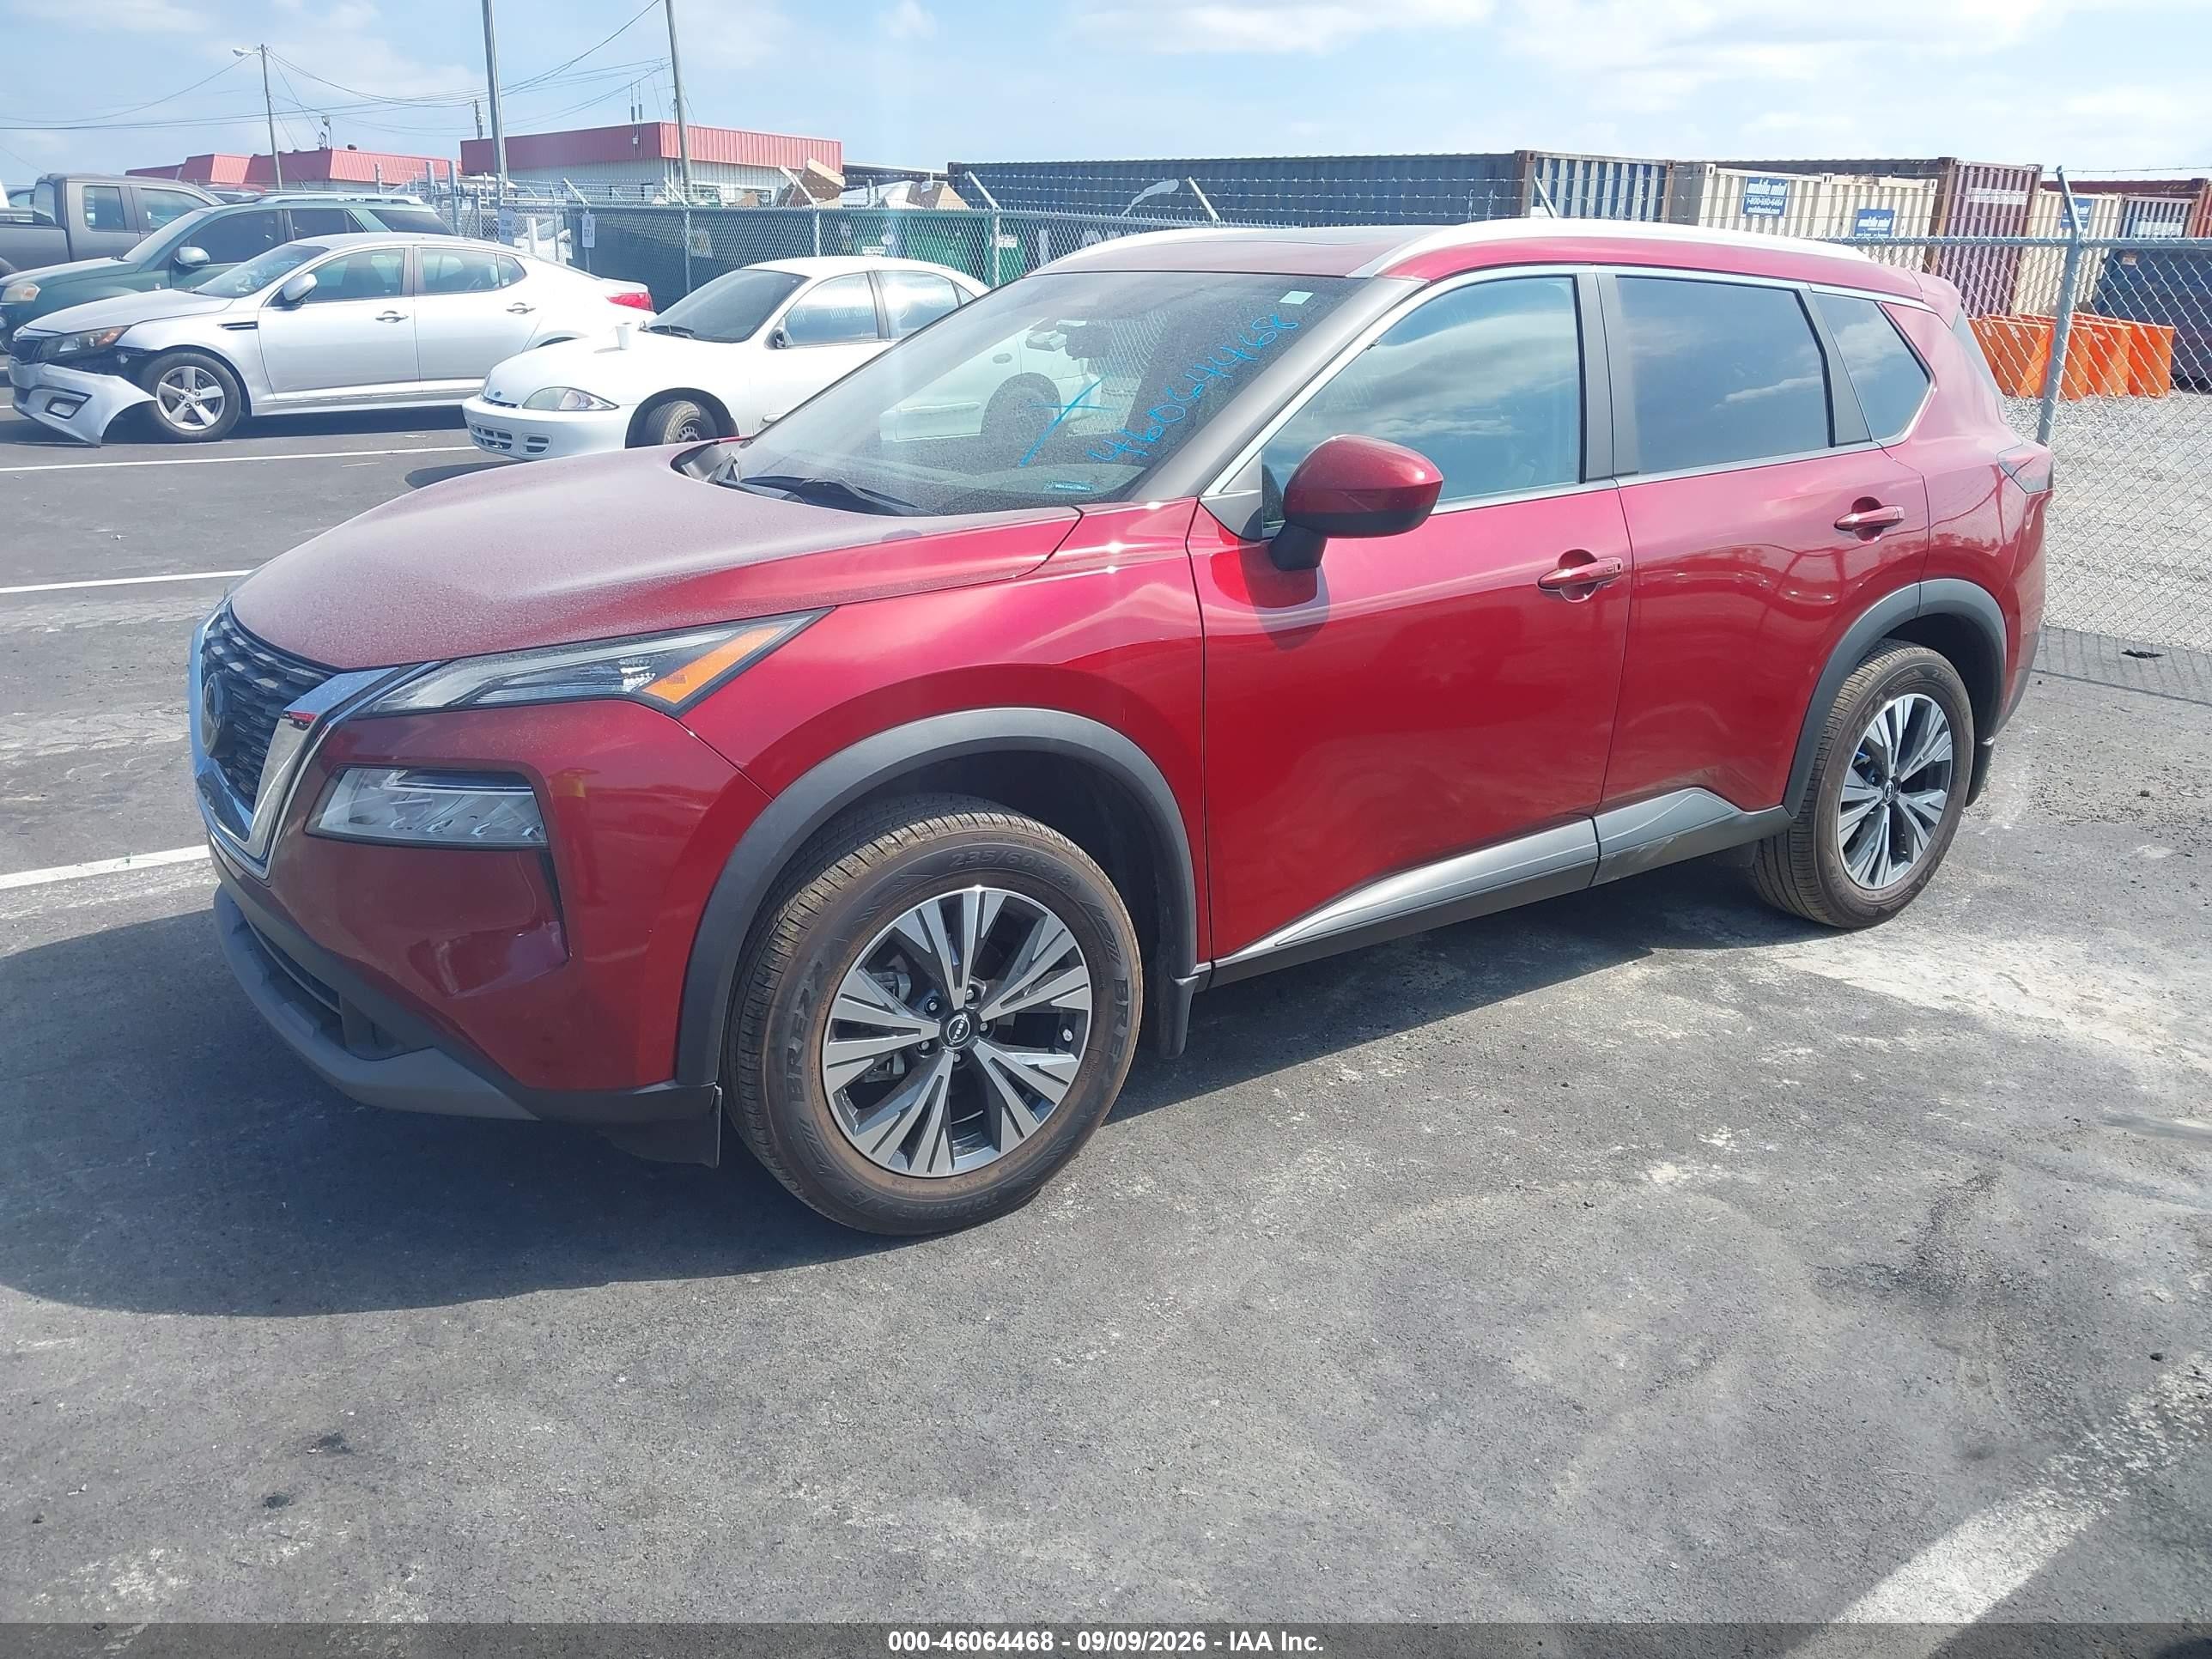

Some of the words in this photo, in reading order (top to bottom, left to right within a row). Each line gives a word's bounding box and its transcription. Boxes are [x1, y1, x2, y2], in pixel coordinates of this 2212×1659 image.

[1747, 179, 1771, 195] mobile
[1770, 182, 1787, 196] mini
[1086, 314, 1299, 461] 46064468
